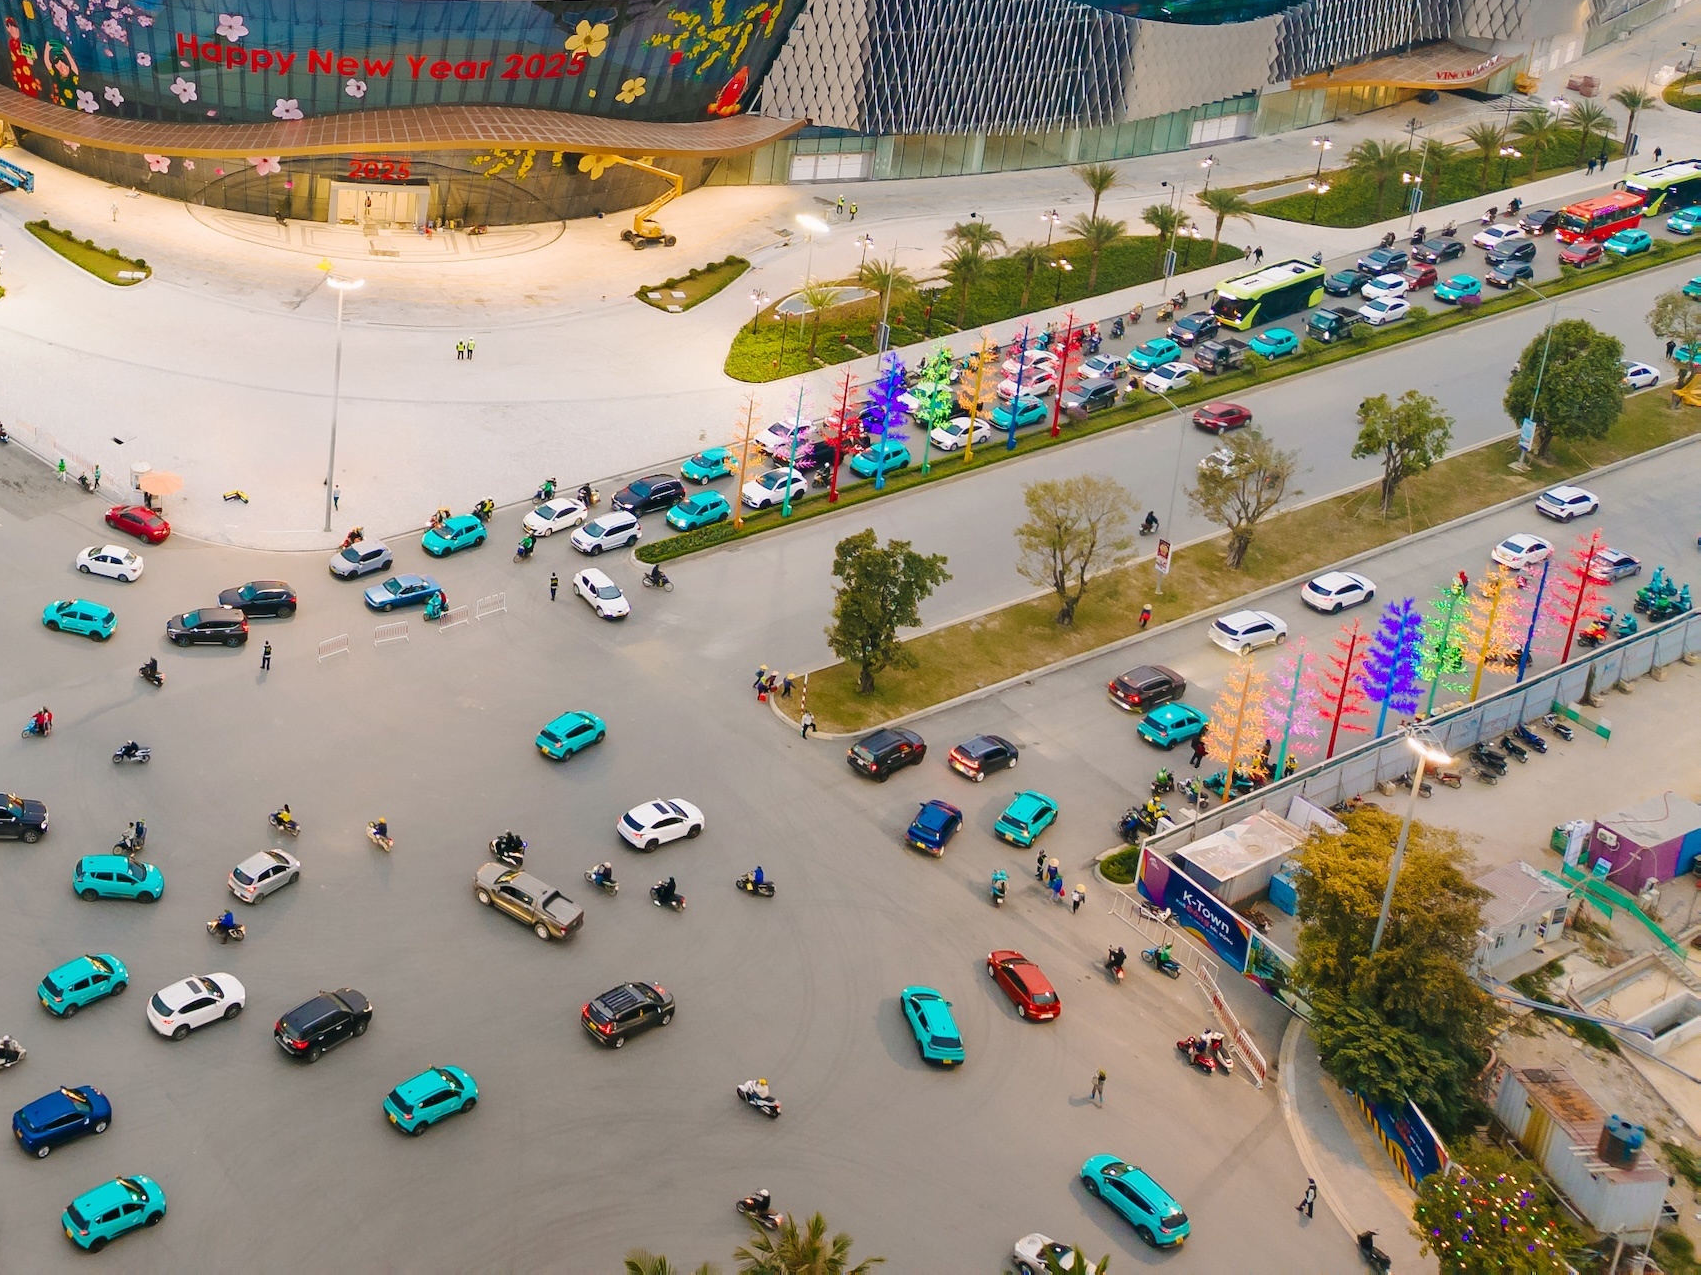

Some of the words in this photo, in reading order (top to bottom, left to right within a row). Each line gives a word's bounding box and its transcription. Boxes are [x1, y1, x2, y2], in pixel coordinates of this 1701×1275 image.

[176, 32, 297, 76] Happy
[307, 49, 394, 78] New
[405, 53, 493, 81] Year
[501, 51, 588, 81] 2025
[348, 159, 412, 180] 2025
[1183, 890, 1230, 934] K-Town
